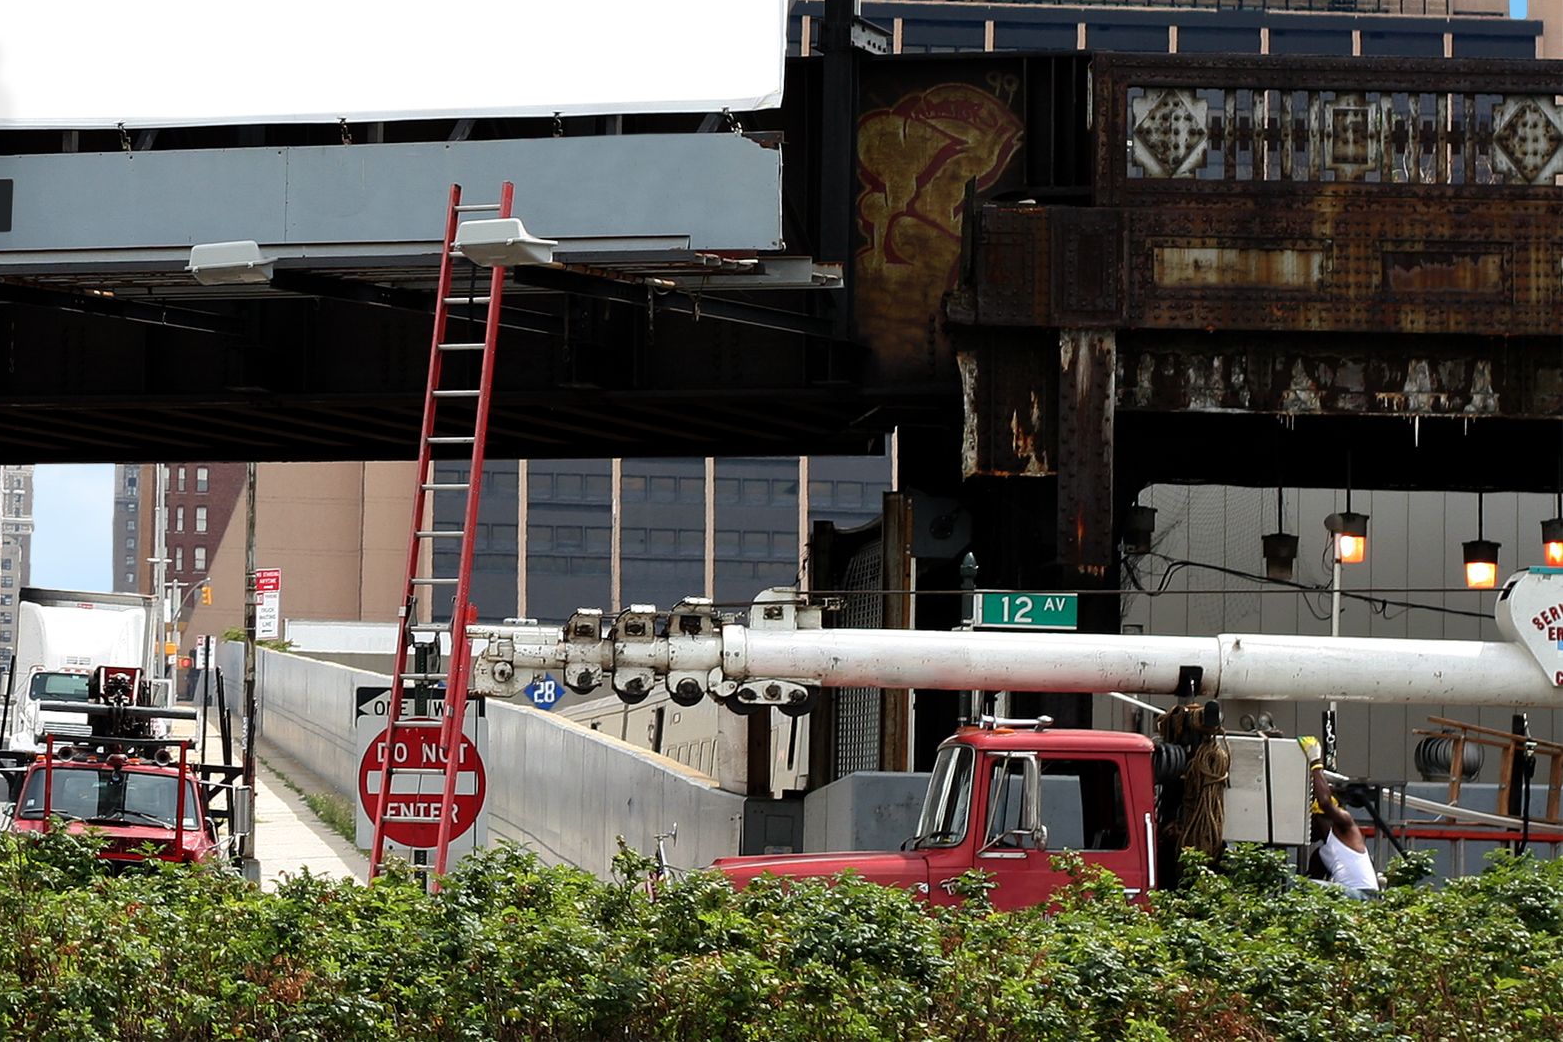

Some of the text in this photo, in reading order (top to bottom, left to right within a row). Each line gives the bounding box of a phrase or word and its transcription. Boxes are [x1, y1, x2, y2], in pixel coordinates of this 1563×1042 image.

[1001, 596, 1066, 623] 12 AV
[533, 680, 555, 703] 28
[374, 701, 409, 716] OE
